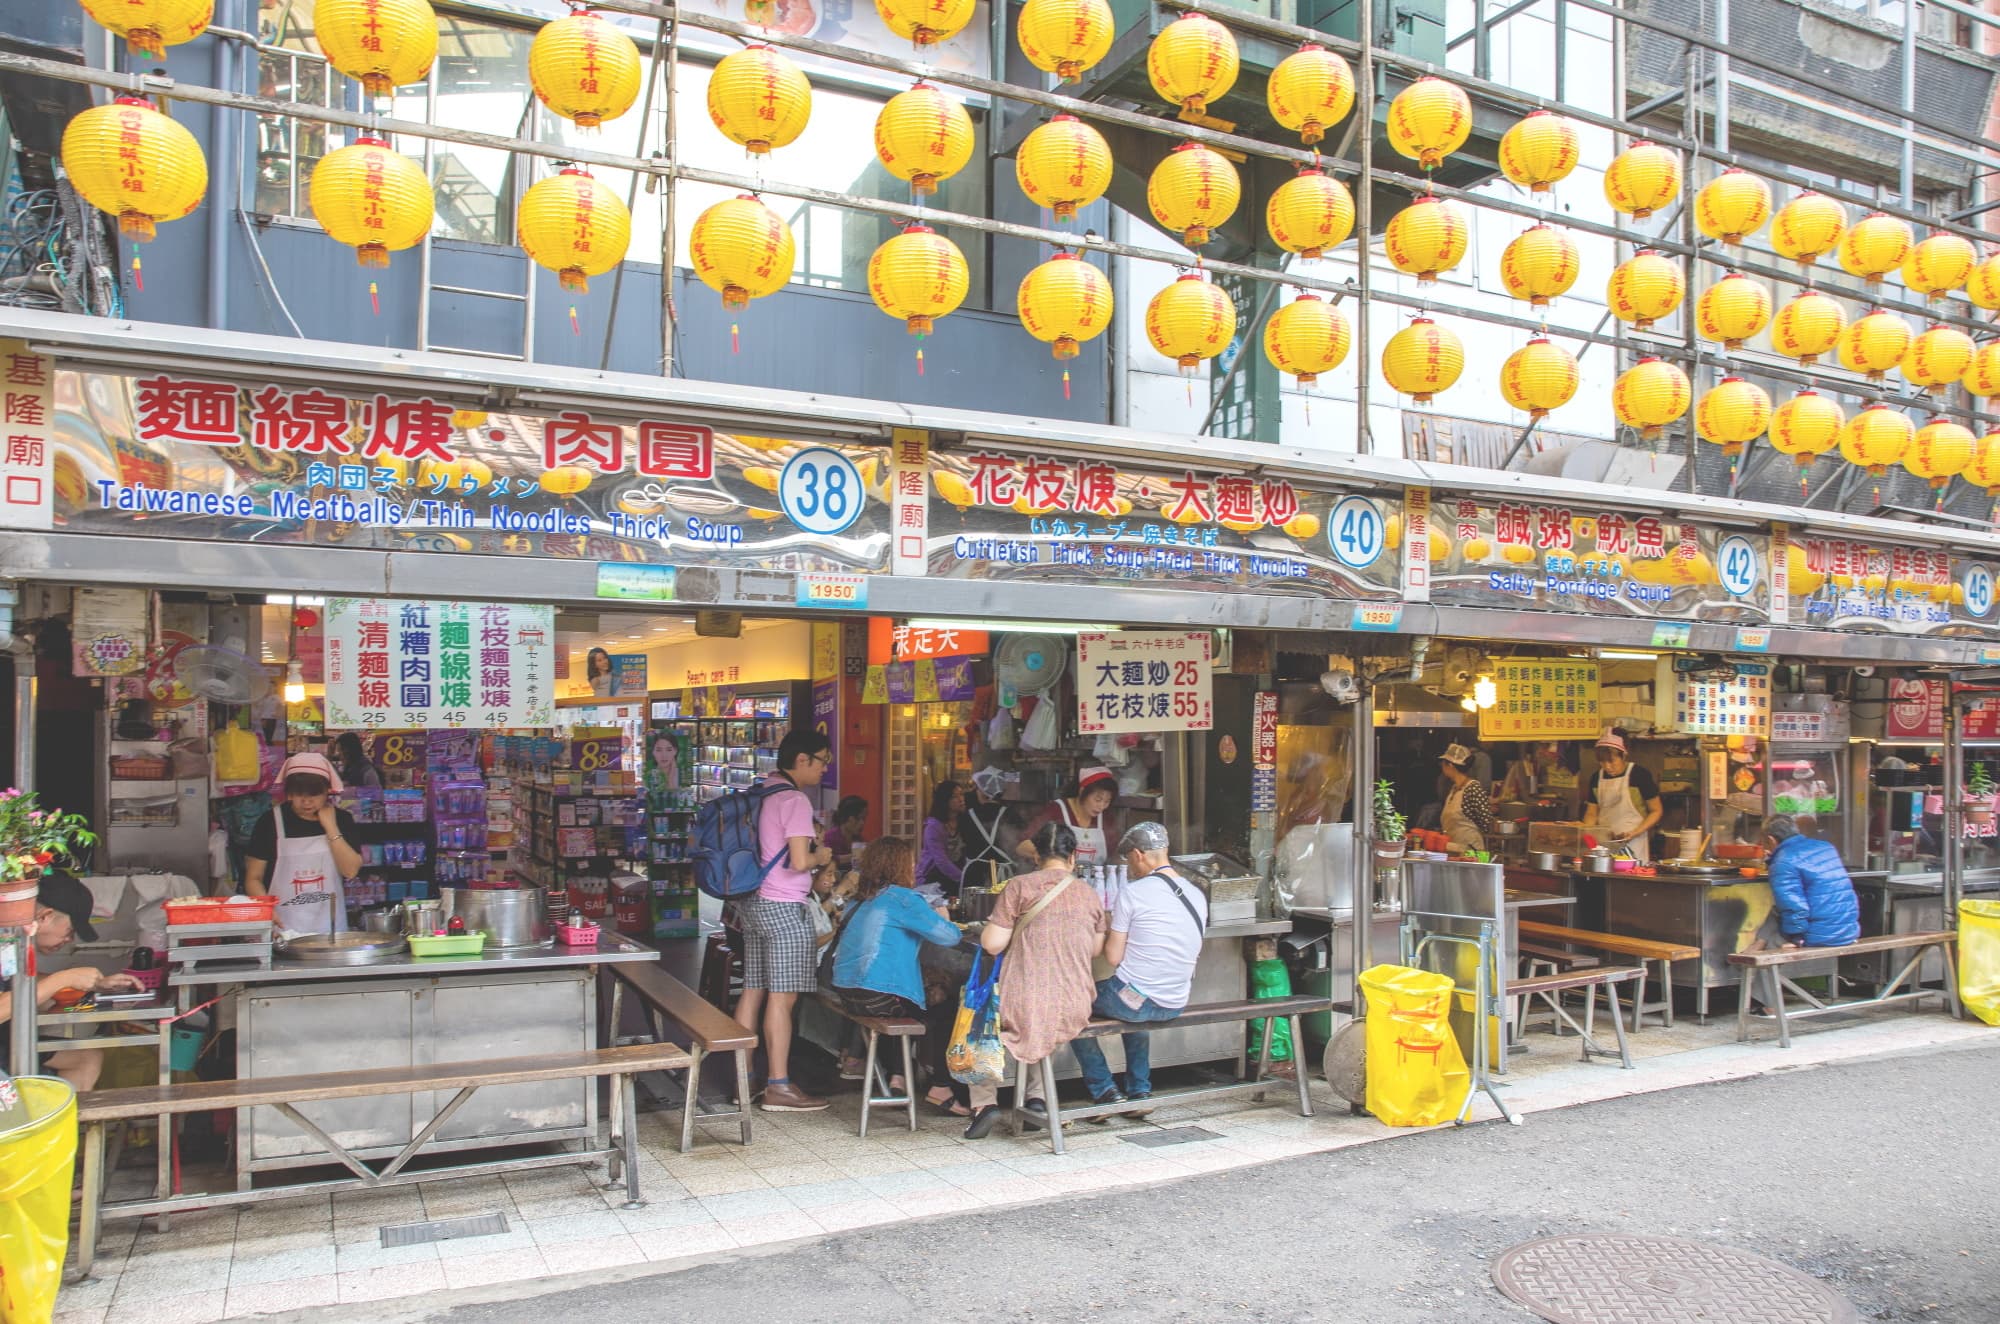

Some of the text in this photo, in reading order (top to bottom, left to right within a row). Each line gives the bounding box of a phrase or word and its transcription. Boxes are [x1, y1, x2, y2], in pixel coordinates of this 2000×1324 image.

[5, 352, 46, 506] 基隆廟口
[795, 461, 848, 521] 38
[898, 439, 925, 560] 基隆廟口
[96, 478, 253, 516] Taiwanese
[490, 503, 591, 535] Noodles
[607, 511, 670, 540] Thick
[686, 516, 743, 545] Soup
[1344, 507, 1375, 554] 40
[1456, 500, 1479, 540] 燒肉
[954, 536, 1309, 578] Cuttlefish Thick Soup Fried Thick Noodles
[1725, 547, 1751, 585] 42
[815, 584, 852, 599] 1950
[1489, 571, 1536, 596] Salty
[1968, 572, 1989, 608] 46
[1365, 612, 1391, 624] 1950
[1840, 599, 1864, 616] Rice
[1901, 605, 1922, 620] Fish
[357, 620, 391, 708] 清麵線
[1096, 660, 1198, 687] 大麵炒 25
[361, 711, 509, 723] 25 35 45 45
[1174, 692, 1198, 717] 55
